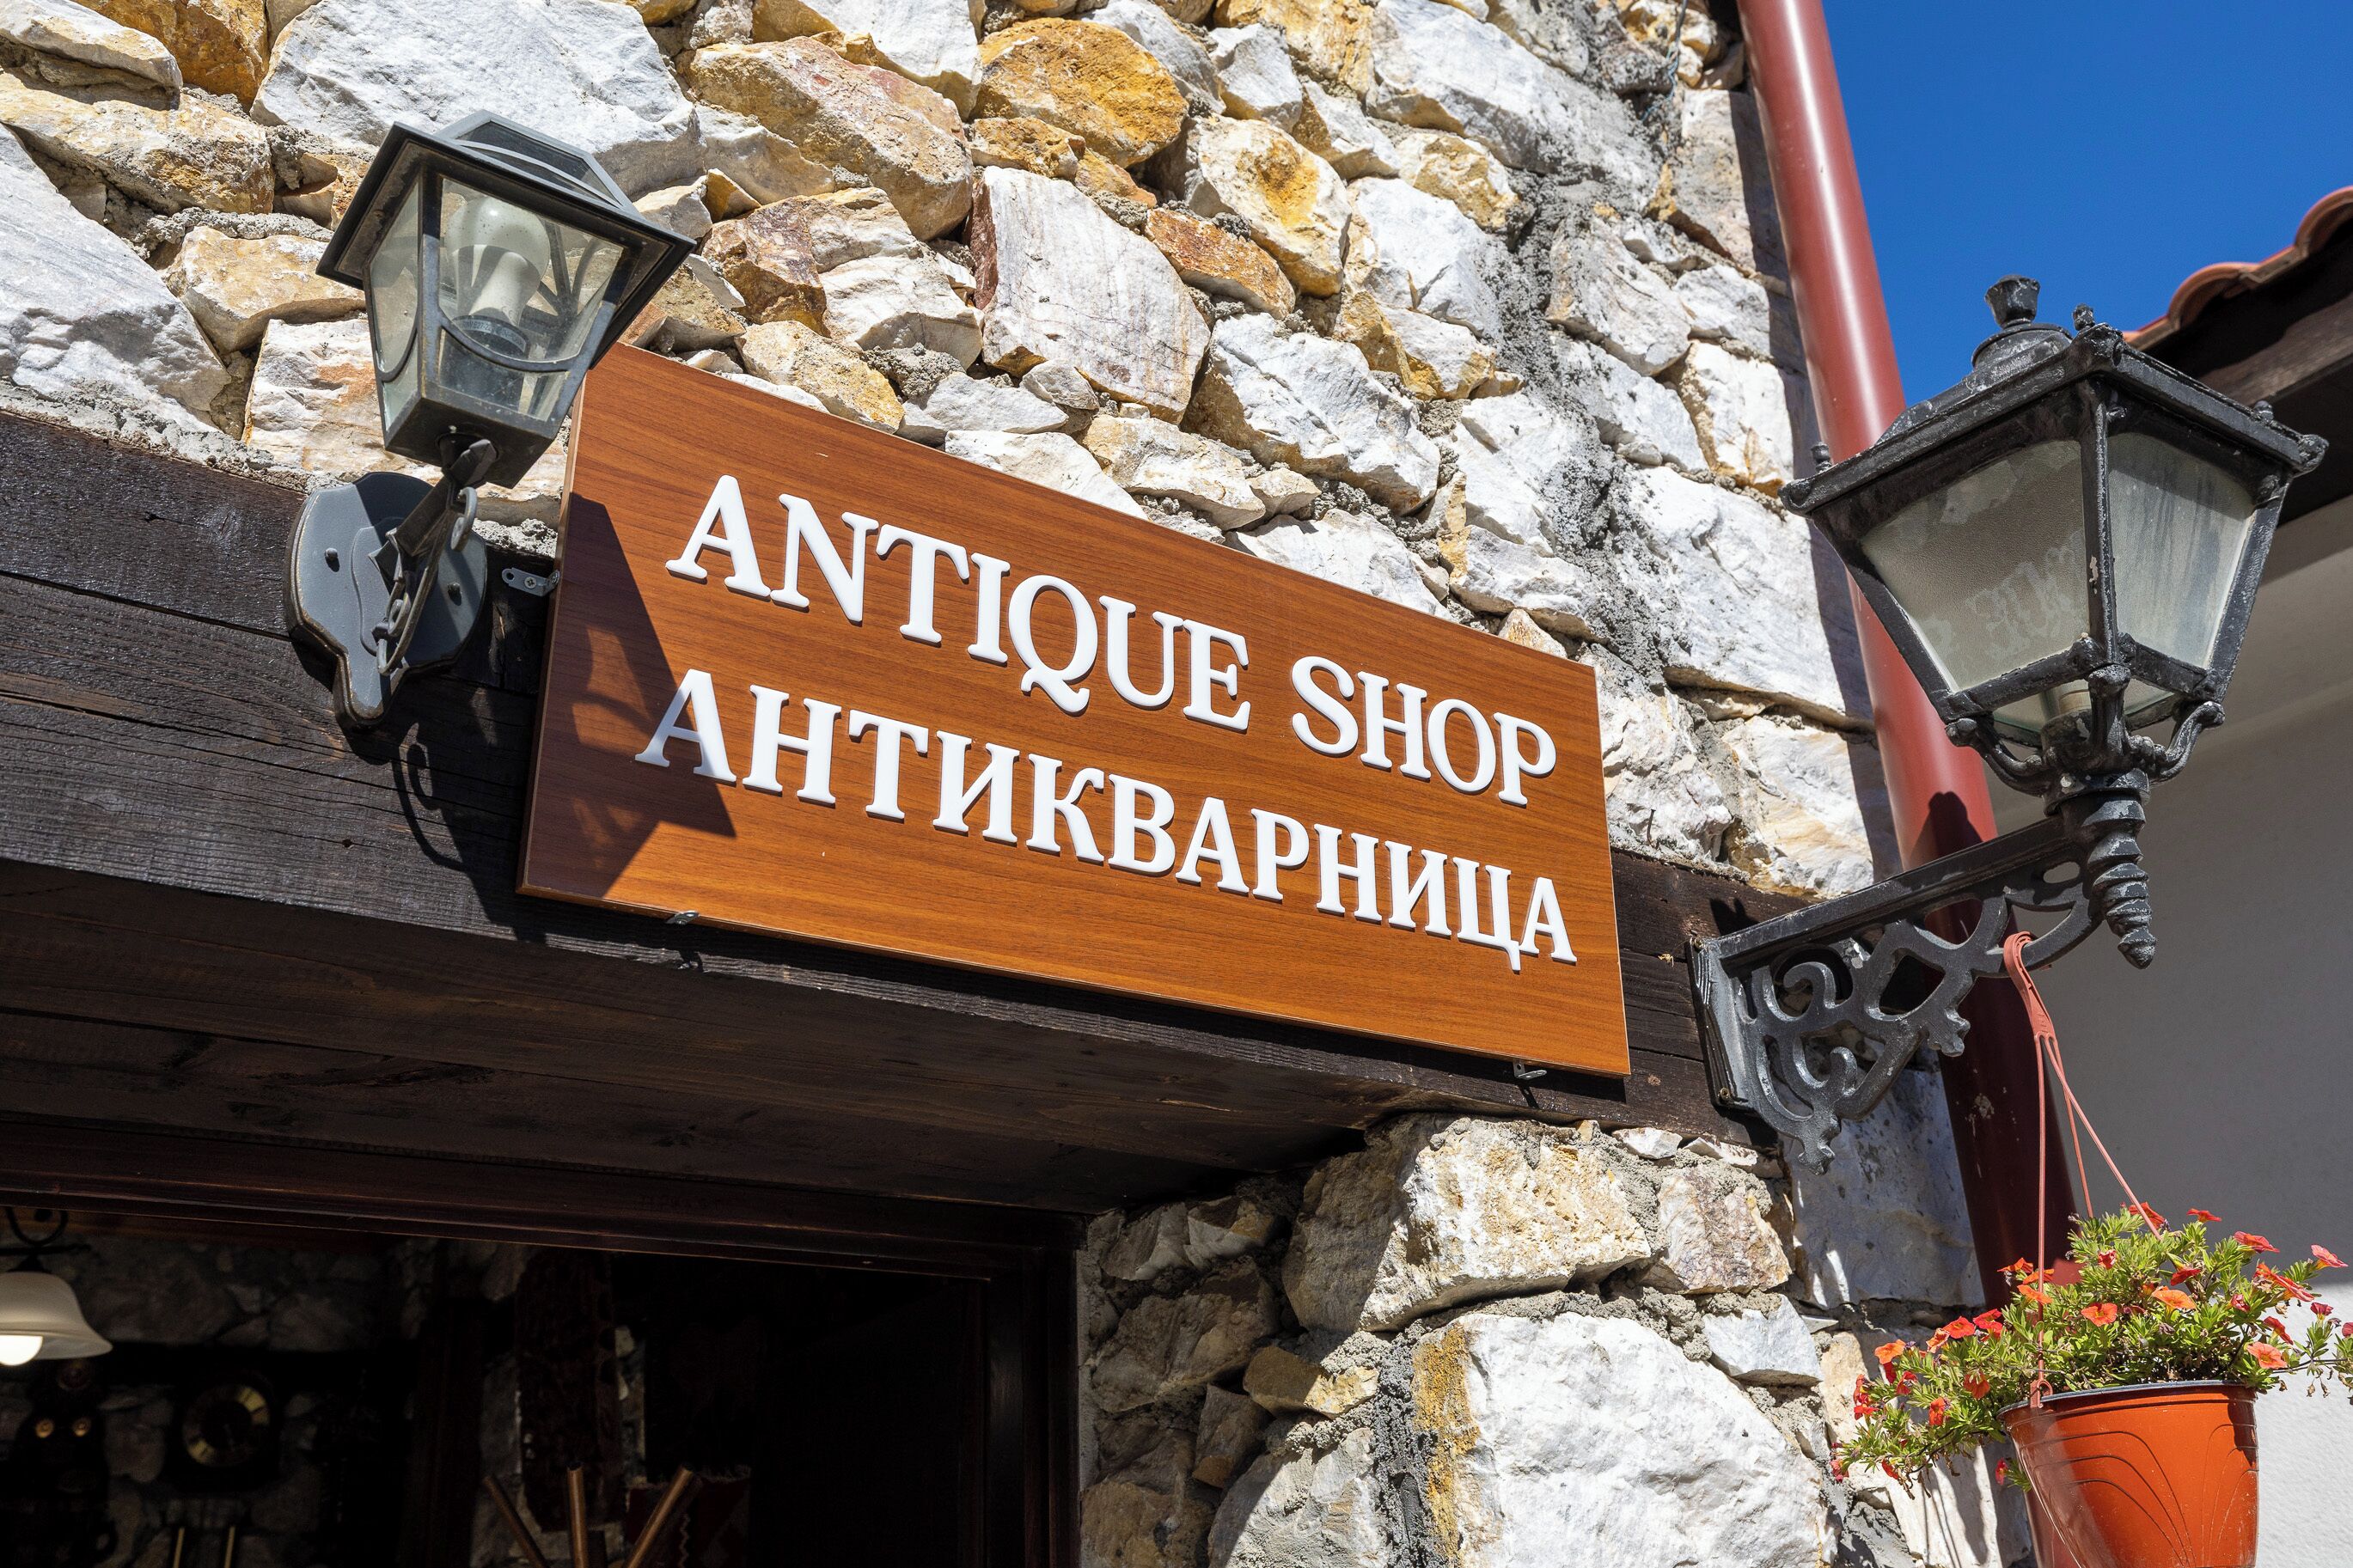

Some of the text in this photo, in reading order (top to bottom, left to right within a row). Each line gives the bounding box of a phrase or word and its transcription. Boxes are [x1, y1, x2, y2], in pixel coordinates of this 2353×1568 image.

[665, 474, 1557, 805] ANTIQUE SHOP
[635, 668, 1578, 971] АНТИКВАРНИЦА
